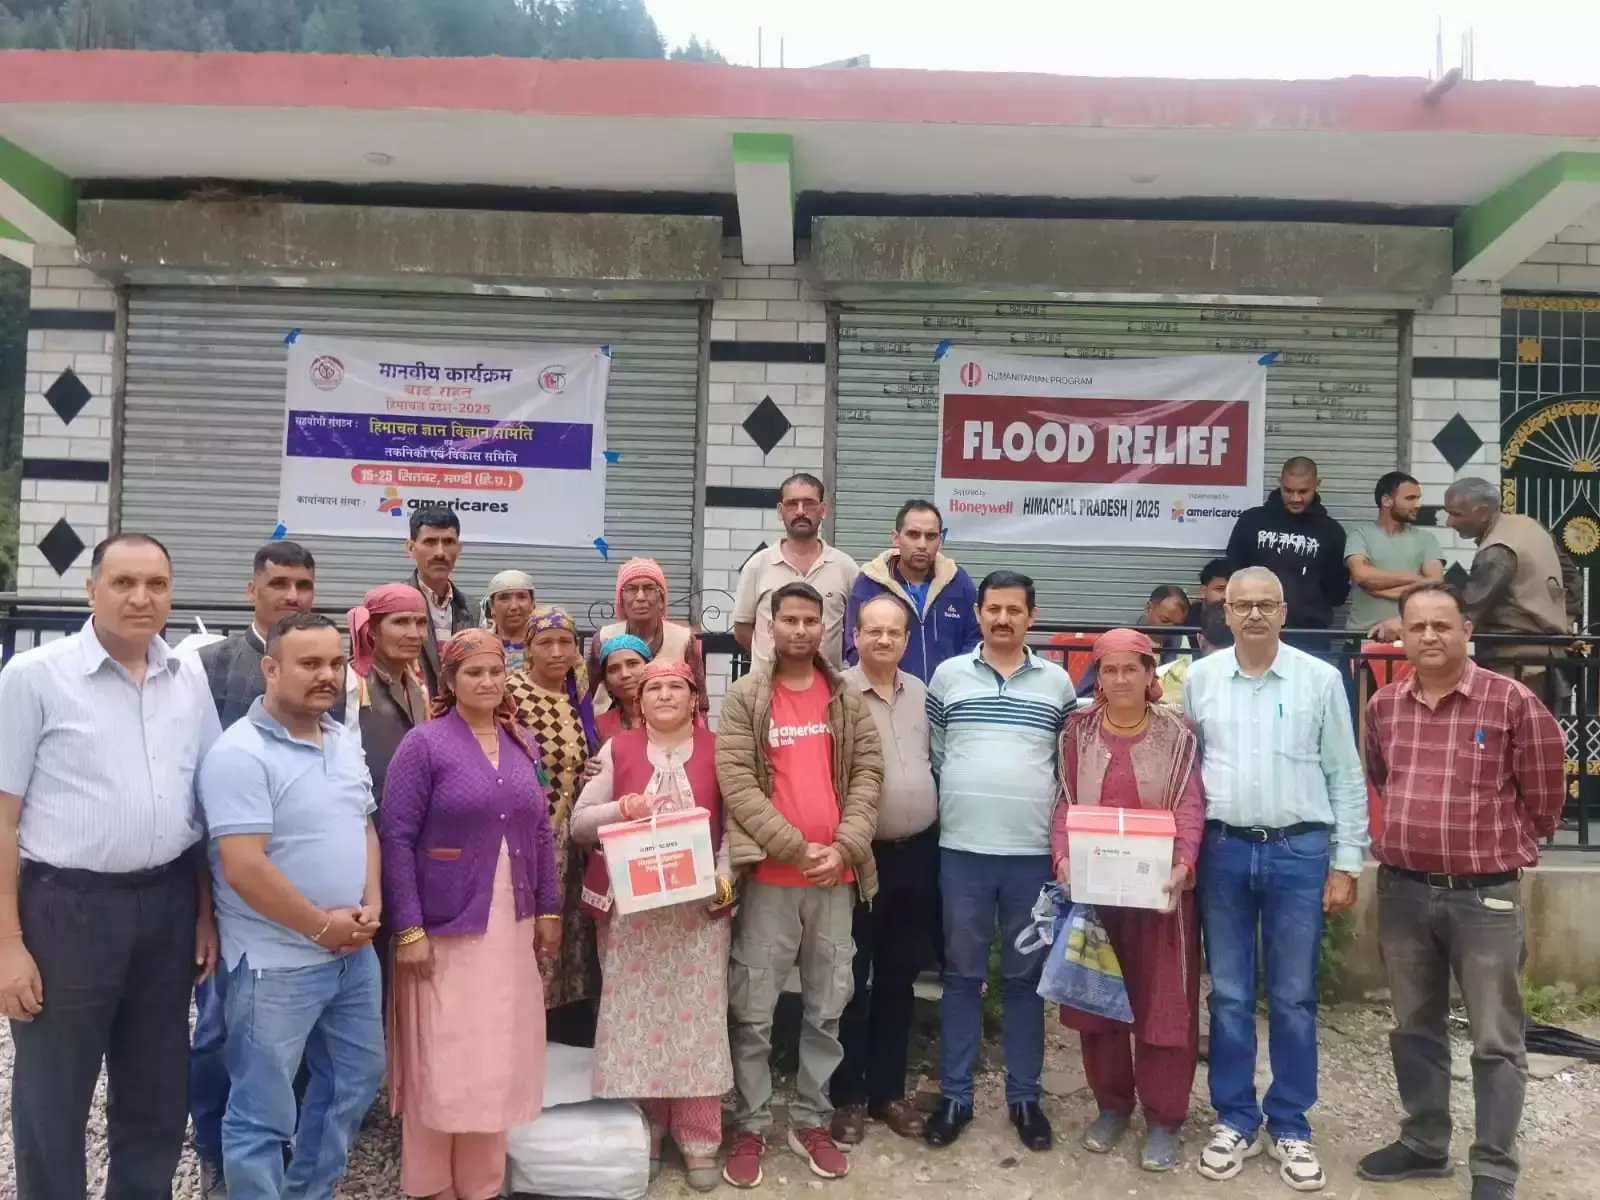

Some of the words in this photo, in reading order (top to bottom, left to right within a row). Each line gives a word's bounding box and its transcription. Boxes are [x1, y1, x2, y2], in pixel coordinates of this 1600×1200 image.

[379, 361, 440, 382] मानवीय
[445, 363, 514, 383] कार्यक्रम
[987, 371, 1049, 384] HUMANITARIAN
[1050, 376, 1093, 385] PROGRAM
[368, 416, 418, 436] हिमाचल
[421, 423, 447, 437] ज्ञान
[451, 421, 490, 439] विज्ञान
[963, 420, 1094, 463] FLOOD
[1107, 425, 1230, 465] RELIEF
[448, 447, 481, 460] विकास
[484, 449, 518, 463] समिति
[407, 498, 509, 512] americares
[949, 499, 1013, 516] Honeywell
[1023, 497, 1077, 516] HIMACHAL
[1079, 499, 1128, 517] PRADESH
[1135, 500, 1160, 518] 2025
